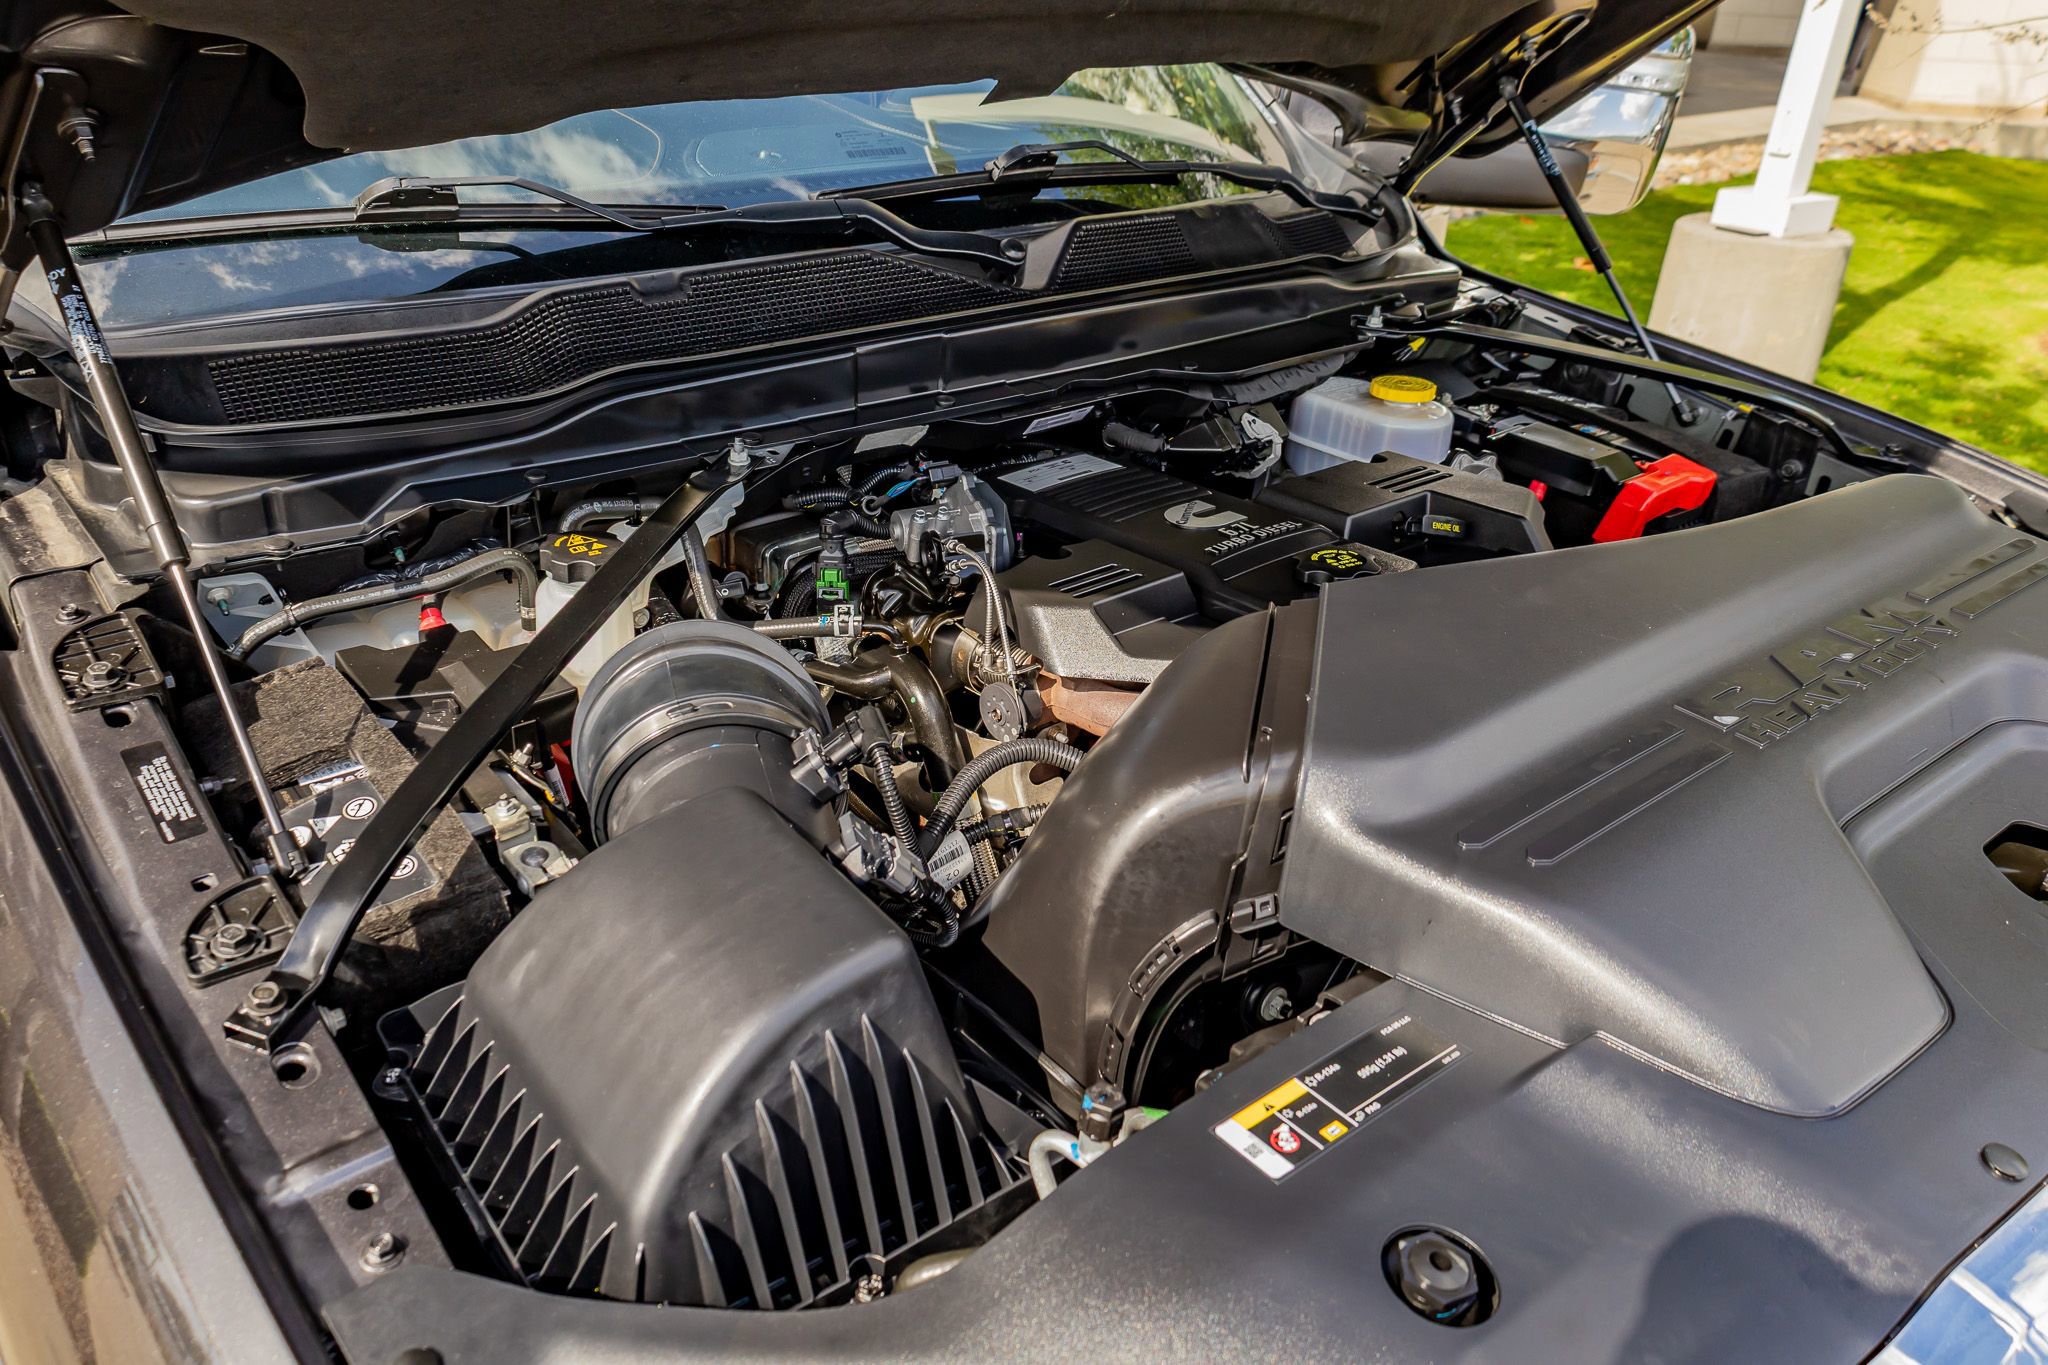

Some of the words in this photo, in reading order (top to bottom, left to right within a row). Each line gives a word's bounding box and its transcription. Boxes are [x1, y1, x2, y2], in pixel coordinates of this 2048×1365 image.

[1204, 534, 1256, 555] TURBO
[1256, 520, 1303, 539] DIESEL
[1218, 522, 1260, 537] 6.7L
[1432, 521, 1452, 532] ENGINE
[1452, 523, 1461, 533] OIL
[1673, 607, 1935, 732] RAM
[1735, 670, 1873, 748] HEAVY
[1860, 618, 1962, 678] DUTY
